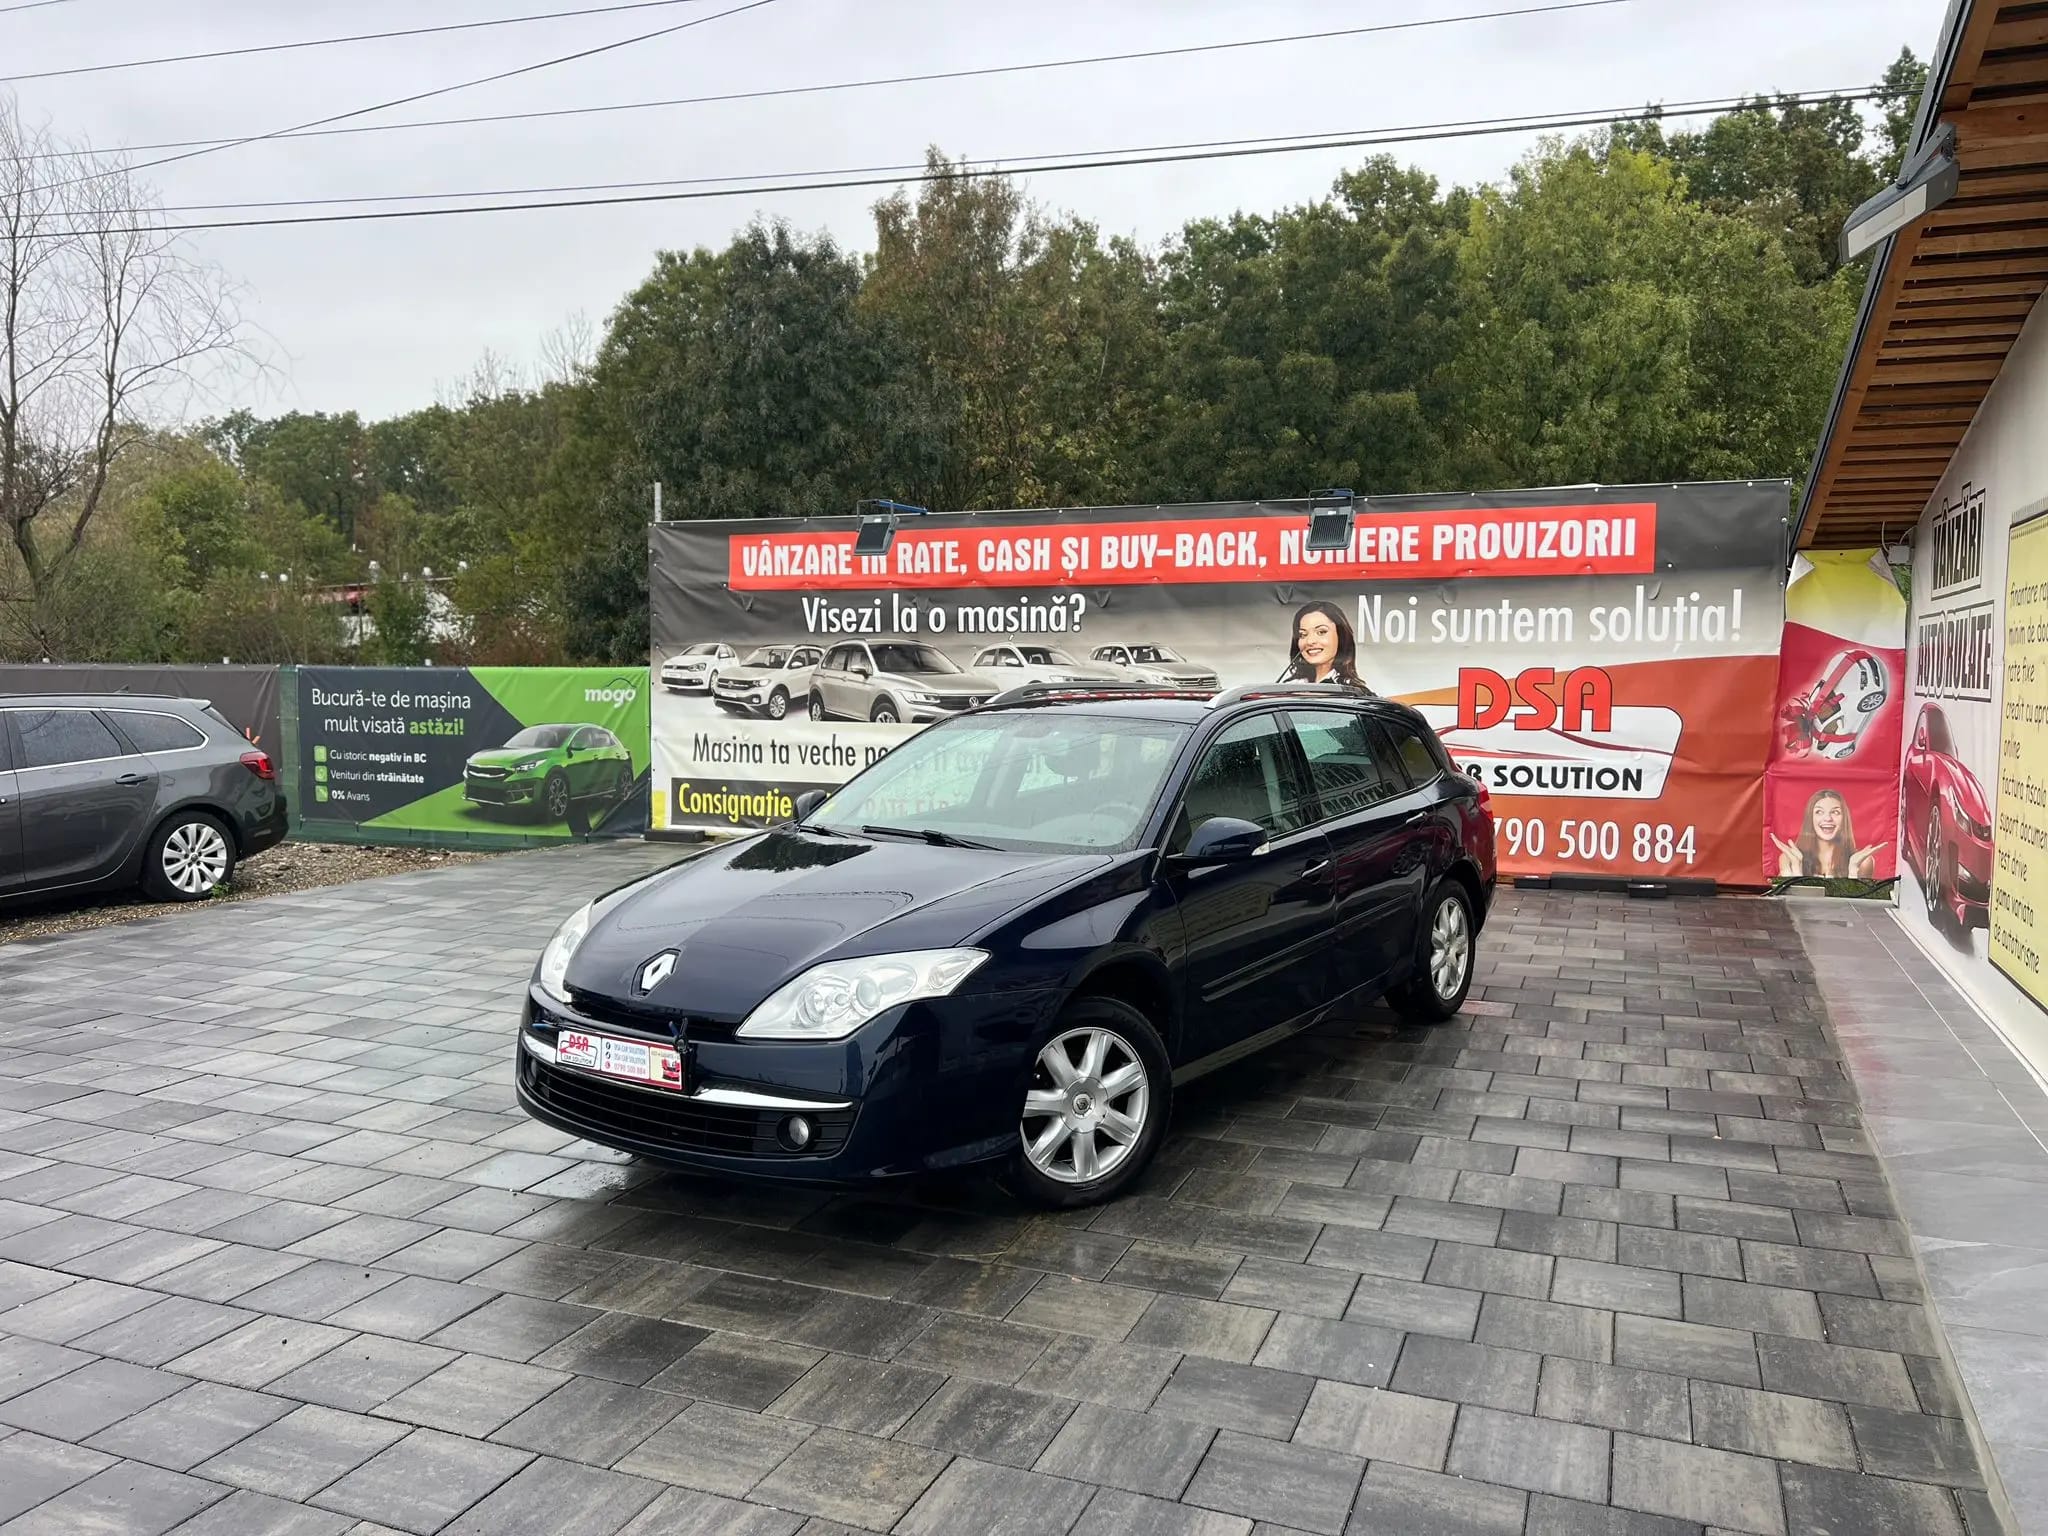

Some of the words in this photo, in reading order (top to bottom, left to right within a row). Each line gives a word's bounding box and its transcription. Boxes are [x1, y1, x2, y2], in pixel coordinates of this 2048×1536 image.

[742, 539, 852, 577] VÂNZARE
[897, 541, 968, 576] RATE,
[977, 537, 1050, 573] CASH
[1061, 536, 1089, 578] ȘI
[1100, 530, 1267, 569] BUY-BACK,
[1432, 518, 1636, 561] PROVIZORII
[1932, 495, 1983, 590] VÂNZĂRI
[802, 595, 881, 633] Visezi
[892, 592, 918, 633] la
[928, 605, 946, 633] o
[957, 592, 1087, 641] mașină?
[1356, 594, 1418, 644] Noi
[1431, 599, 1573, 644] suntem
[1588, 584, 1743, 653] soluția!
[312, 688, 386, 708] Bucură-te
[390, 690, 410, 708] de
[414, 691, 471, 712] mașina
[585, 689, 636, 709] mogo
[1457, 665, 1612, 733] DSA
[324, 715, 359, 733] mult
[362, 716, 405, 734] visată
[409, 718, 464, 735] astăzi!
[330, 749, 342, 760] Cu
[343, 751, 367, 761] istoric
[369, 752, 402, 764] negativ
[413, 753, 427, 763] BC
[692, 733, 763, 764] Masina
[770, 739, 790, 765] ta
[798, 734, 856, 767] veche
[330, 769, 361, 780] Venituri
[362, 771, 375, 781] din
[376, 772, 425, 783] străinătate
[1493, 765, 1643, 792] SOLUTION
[331, 789, 345, 800] 0%
[346, 791, 370, 802] Avans
[678, 782, 793, 825] Consignație
[1557, 820, 1620, 861] 500
[1631, 823, 1697, 865] 884
[569, 1034, 588, 1051] DSA
